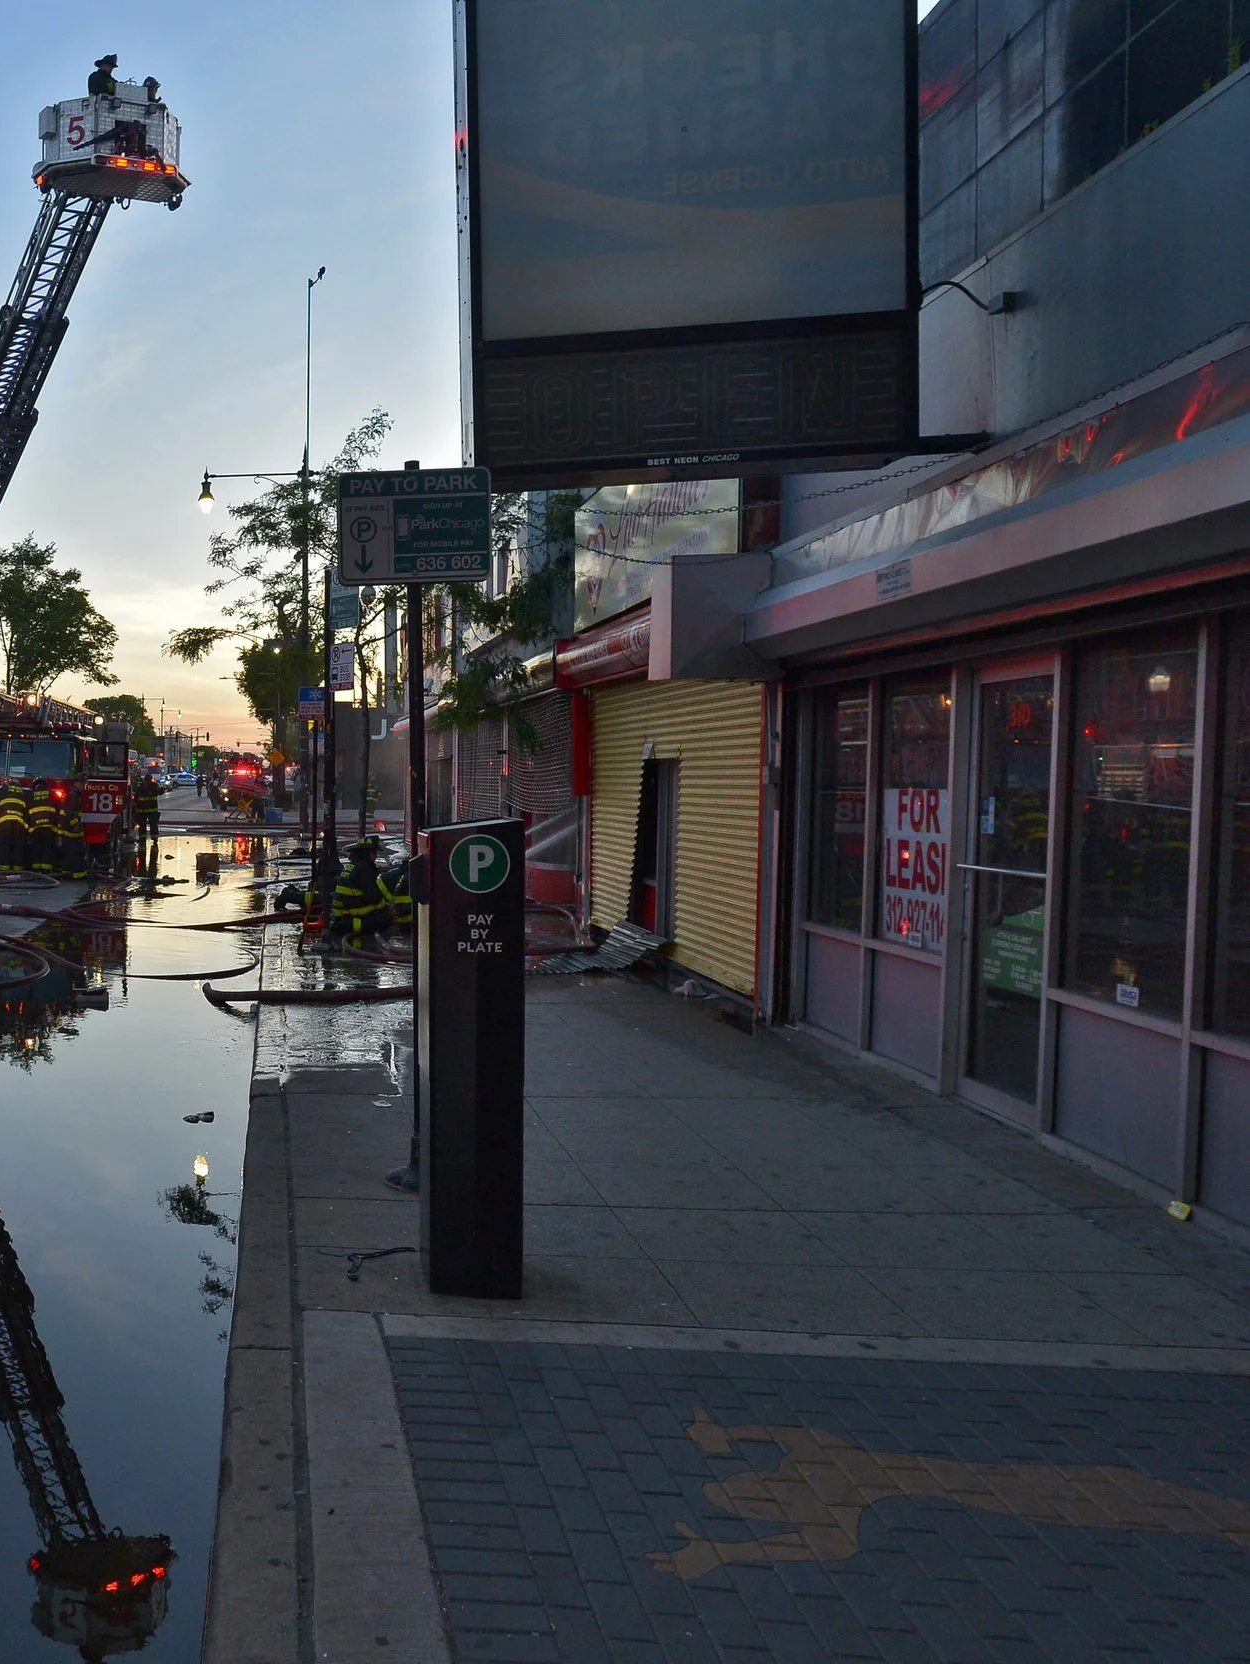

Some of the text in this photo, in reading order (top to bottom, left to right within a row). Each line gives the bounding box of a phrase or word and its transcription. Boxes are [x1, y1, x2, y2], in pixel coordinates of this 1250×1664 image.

[66, 115, 85, 146] 5
[647, 453, 740, 467] BEST NEON CHICAGO
[350, 473, 478, 495] PAY TO PARK
[411, 518, 485, 530] ParkChicago
[431, 540, 459, 548] MOBILE
[416, 556, 447, 571] 636
[451, 555, 483, 569] 602
[340, 665, 349, 673] BUS
[340, 673, 351, 682] STOP
[84, 783, 106, 791] TRUCK
[88, 793, 113, 812] 18
[898, 788, 941, 833] FOR
[469, 844, 495, 883] P
[467, 914, 494, 925] PAY
[470, 929, 489, 939] BY
[457, 942, 503, 953] PLATE
